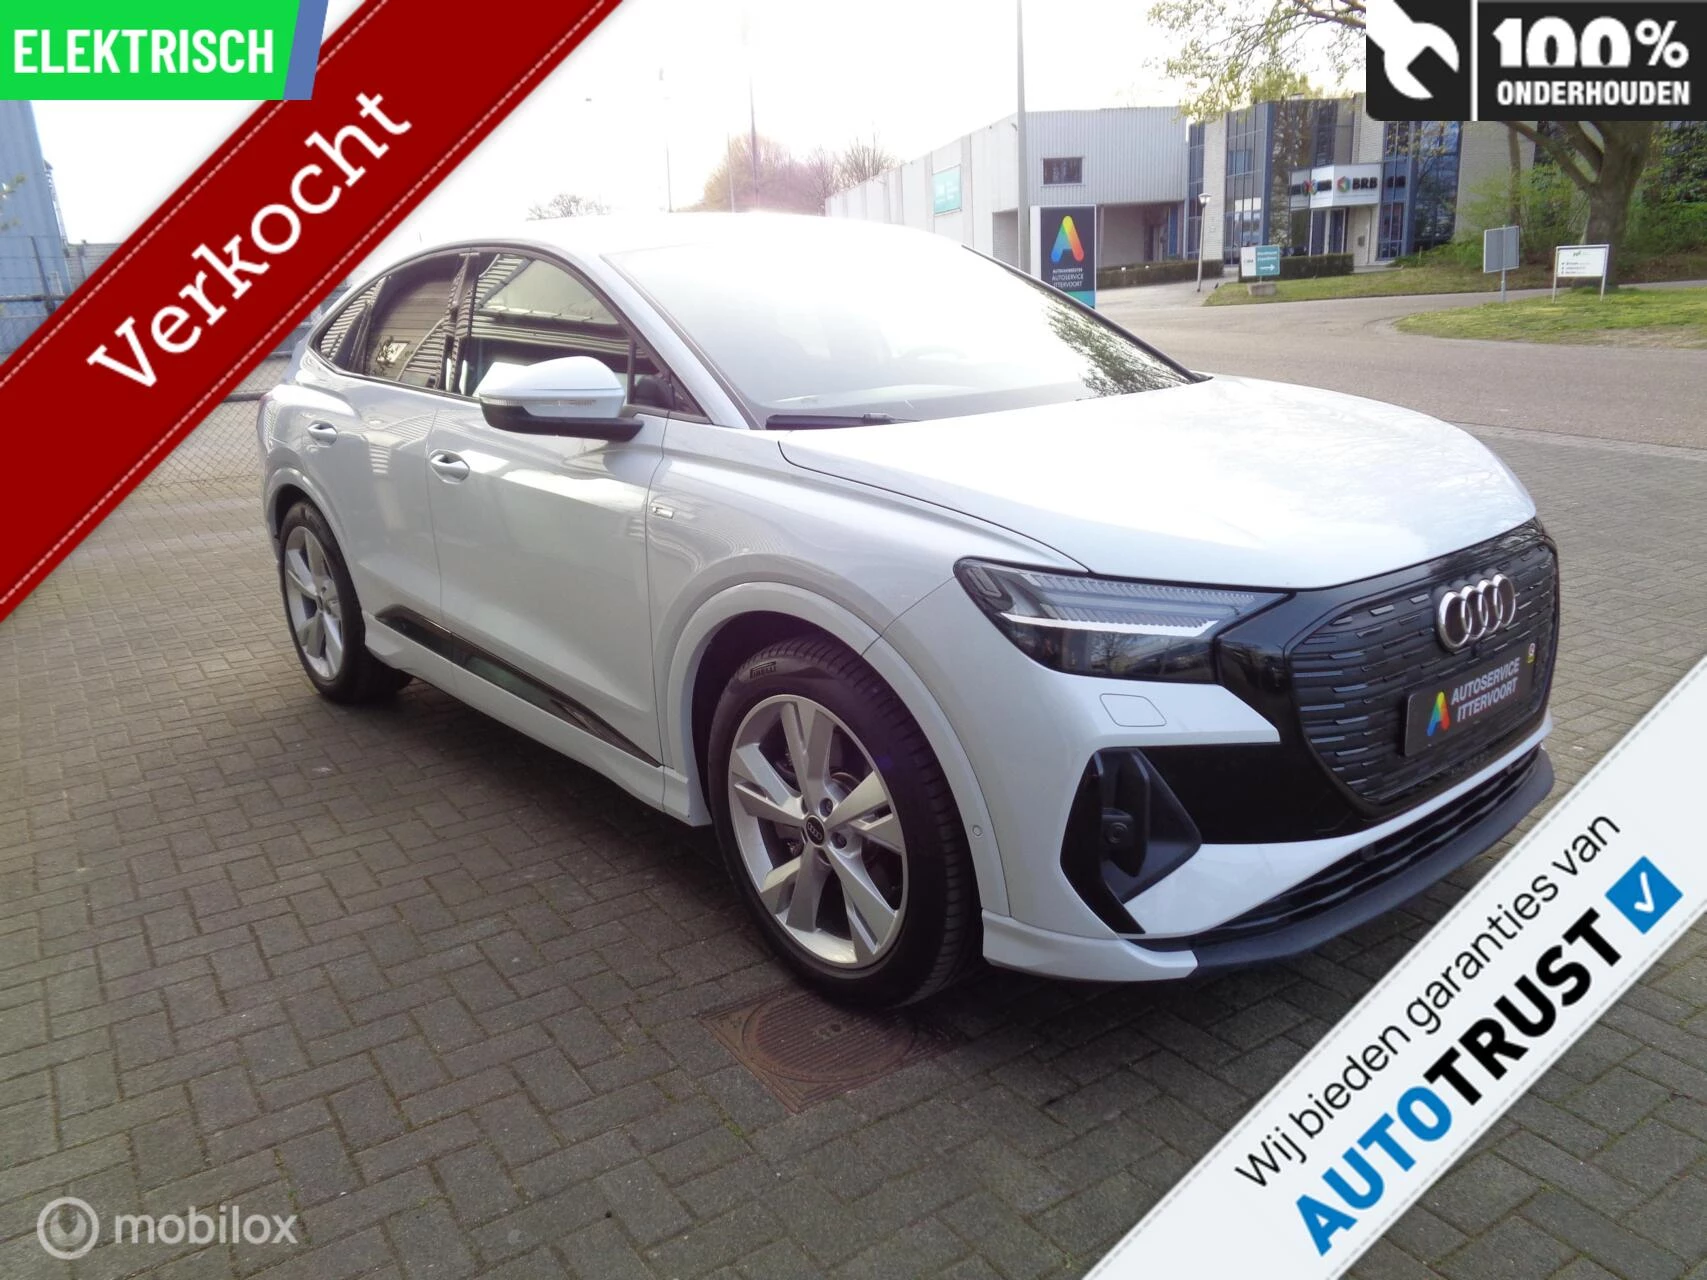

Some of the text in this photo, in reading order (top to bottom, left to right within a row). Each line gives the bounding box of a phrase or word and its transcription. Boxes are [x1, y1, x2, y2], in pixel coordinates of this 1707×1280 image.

[1352, 176, 1378, 190] BRB
[1451, 657, 1520, 705] AUTOSERVICE
[1457, 677, 1518, 722] ITTERVOORT
